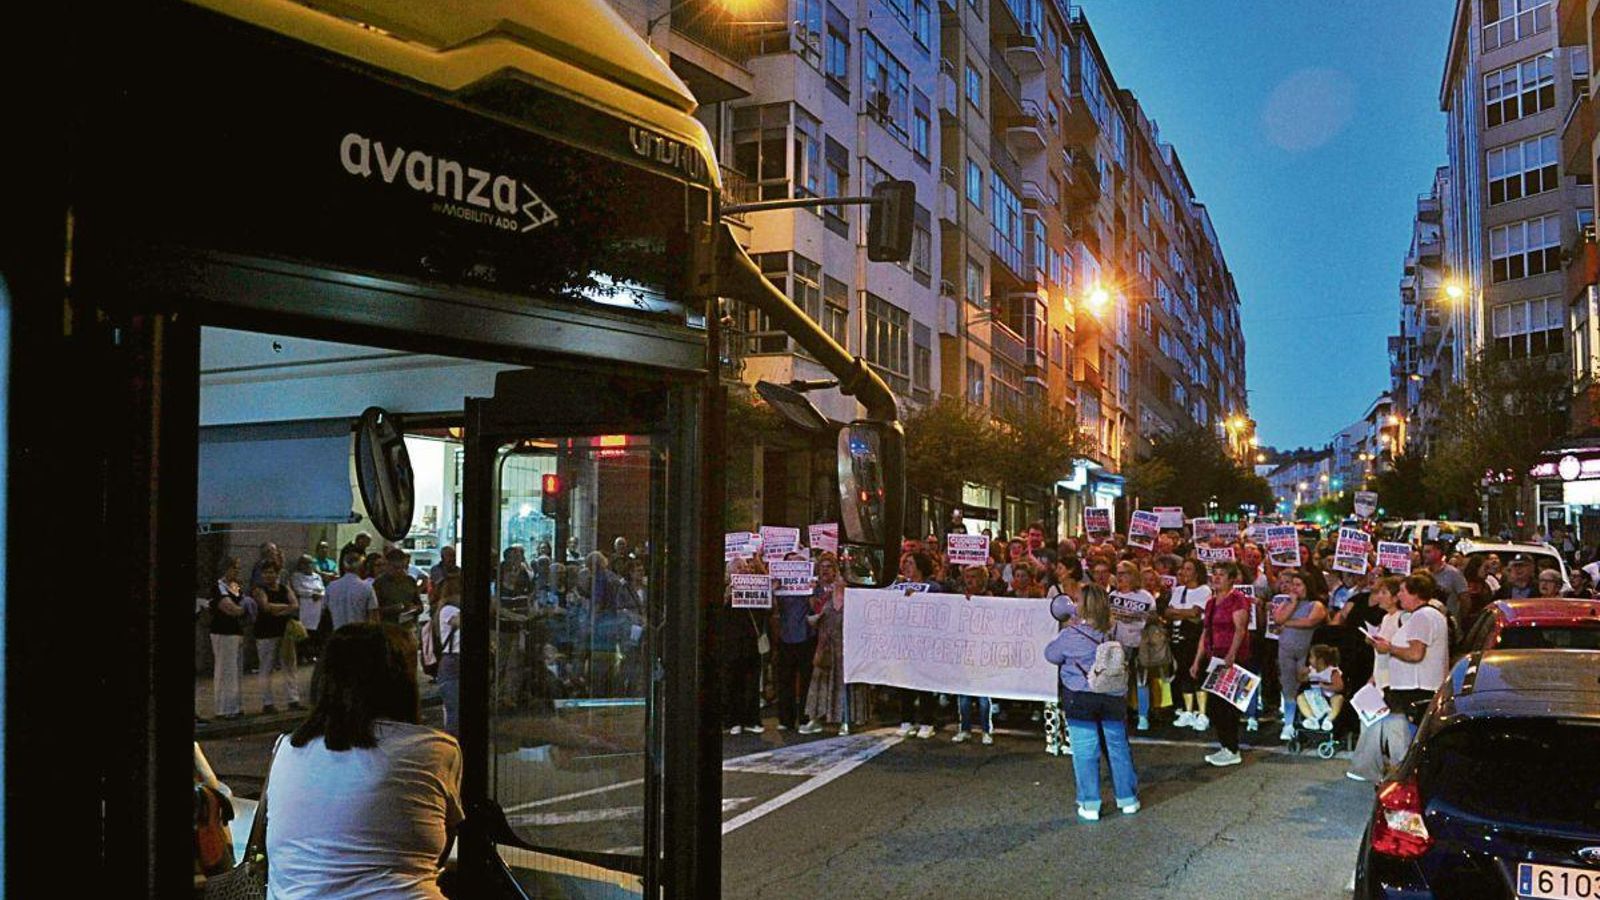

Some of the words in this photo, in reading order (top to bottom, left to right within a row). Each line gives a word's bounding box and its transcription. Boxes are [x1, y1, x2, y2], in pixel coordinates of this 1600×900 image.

[340, 132, 518, 215] avanza
[864, 599, 950, 630] CUDEIRO
[959, 603, 993, 634] POR
[1000, 606, 1036, 637] UN
[1113, 597, 1121, 606] O
[1123, 599, 1146, 611] VISO
[980, 639, 1037, 669] DIGNO
